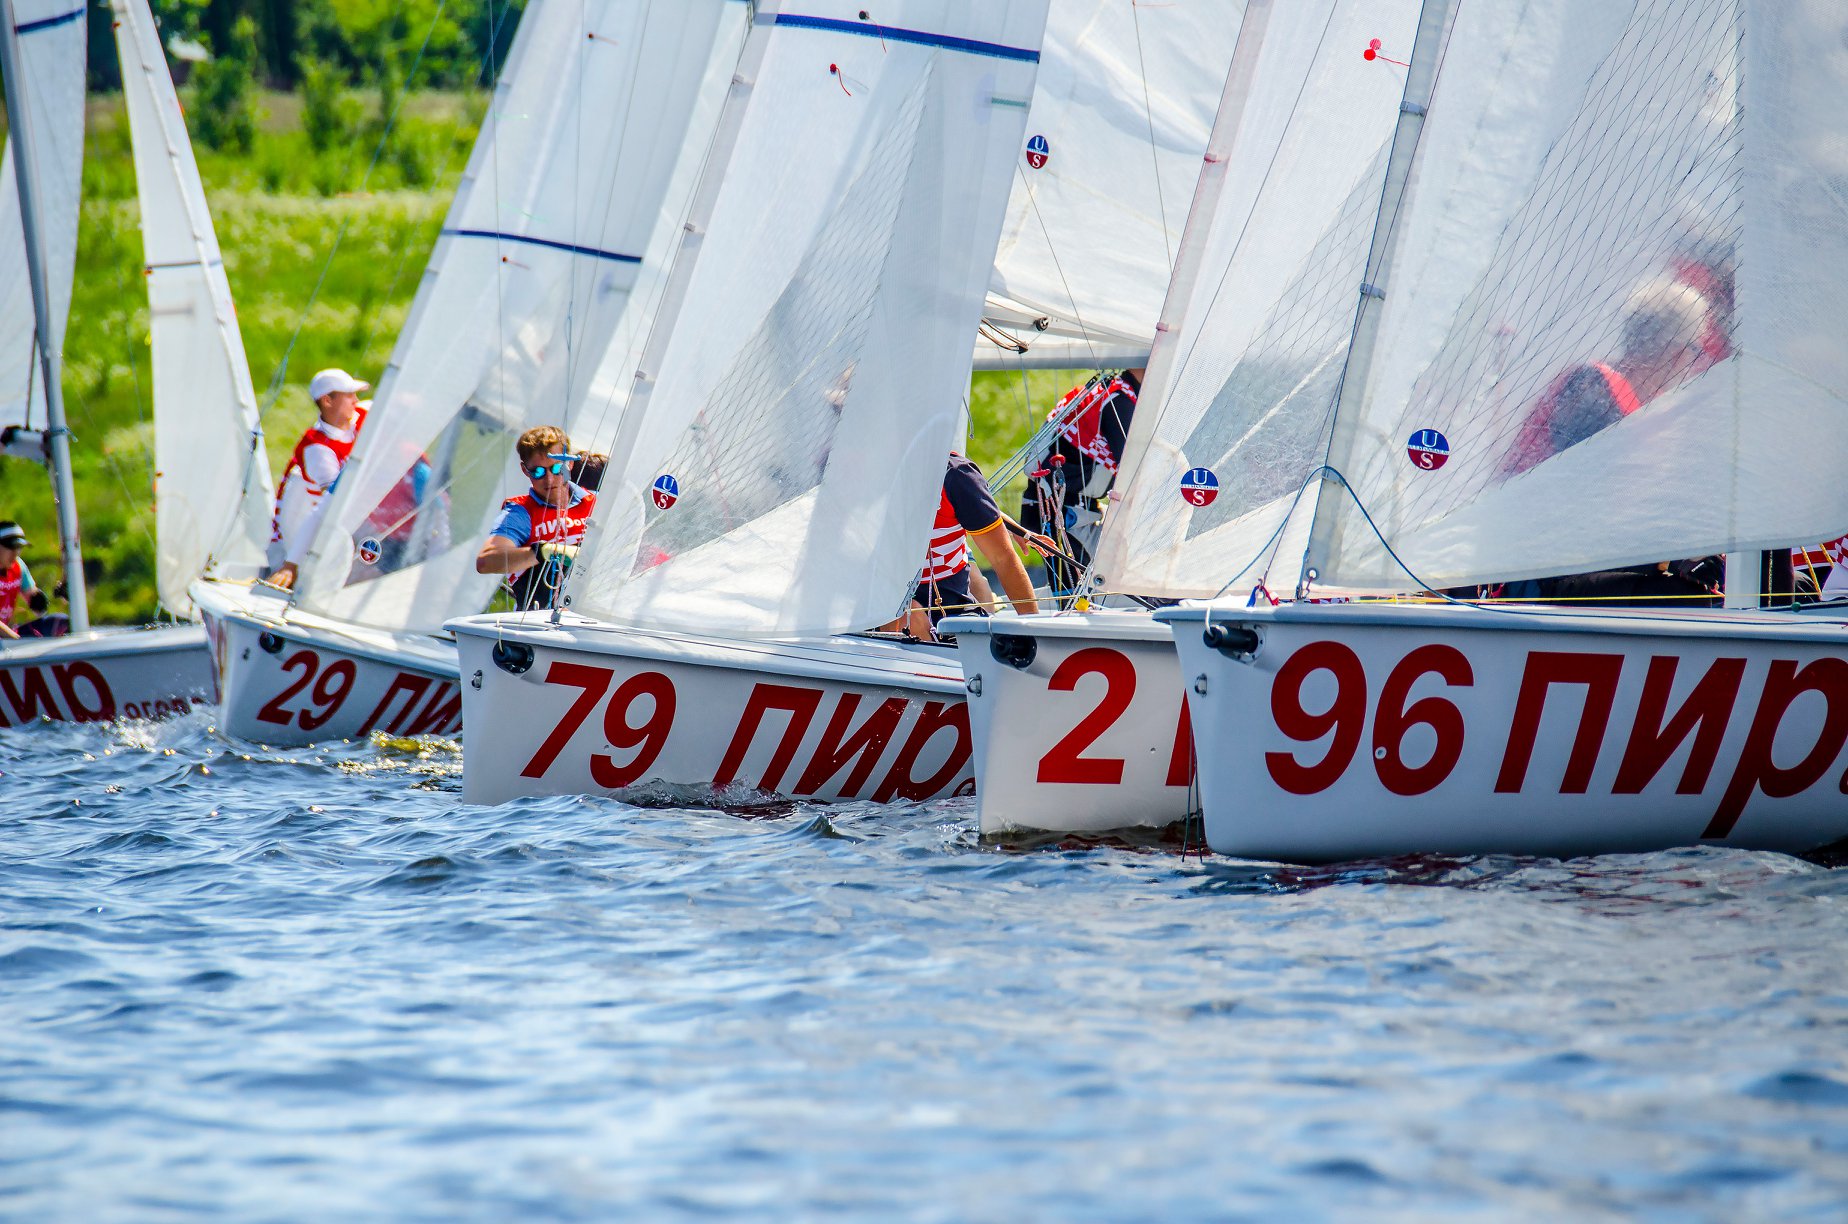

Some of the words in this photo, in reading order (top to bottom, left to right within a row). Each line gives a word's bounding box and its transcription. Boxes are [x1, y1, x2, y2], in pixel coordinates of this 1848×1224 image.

[256, 650, 356, 731] 29
[520, 661, 677, 788] 79
[1036, 647, 1137, 785] 2
[1265, 640, 1475, 796] 96
